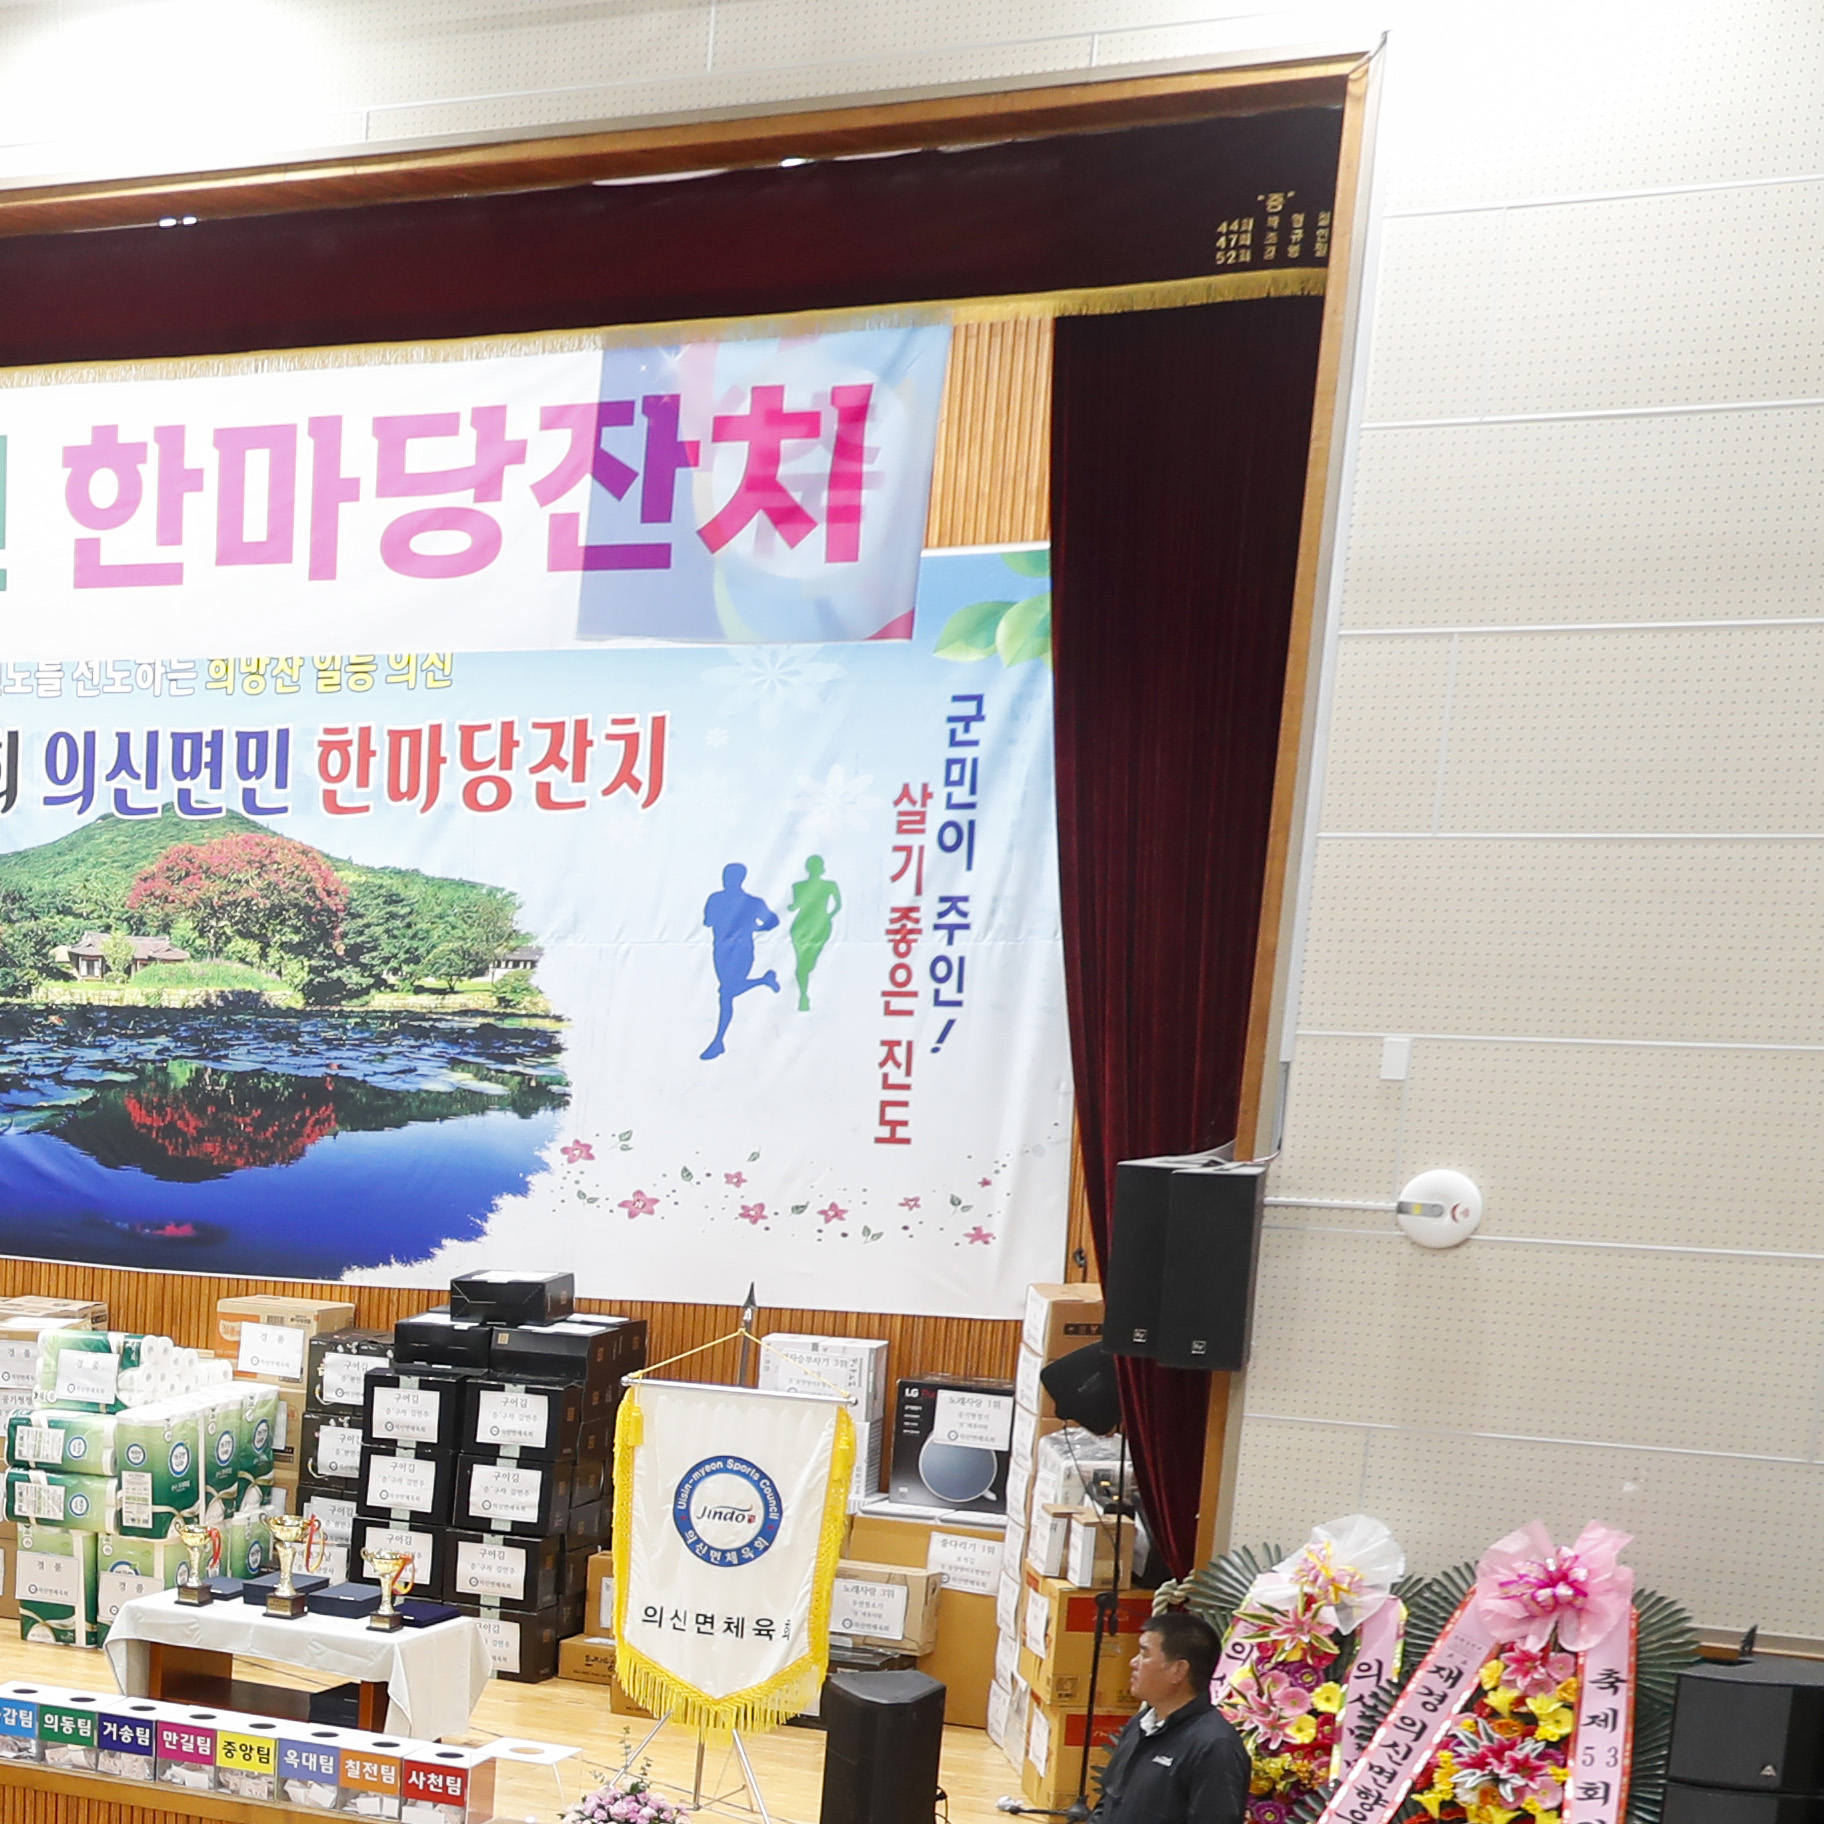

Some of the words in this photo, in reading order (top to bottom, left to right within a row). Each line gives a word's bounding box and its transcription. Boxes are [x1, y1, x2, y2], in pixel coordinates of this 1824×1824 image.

[61, 381, 876, 591] 한마당잔치
[42, 725, 292, 816] 의신면민
[315, 710, 670, 816] 한마당잔치
[937, 693, 986, 871] 군민이
[929, 895, 971, 1054] 주인!
[874, 1038, 914, 1145] 진도
[905, 1387, 919, 1398] LG
[676, 1460, 724, 1510] Uisin-myeon
[726, 1458, 761, 1481] Sports
[759, 1479, 780, 1520] Council
[696, 1505, 746, 1525] Jindo
[684, 1529, 769, 1565] 의신면체육회
[940, 1538, 976, 1553] 줄다리기
[842, 1584, 877, 1598] 노래자랑
[1416, 1664, 1464, 1713] 재경
[1588, 1667, 1628, 1696] 축
[43, 1713, 93, 1738] 의동팀
[102, 1722, 151, 1747] 거송팀
[162, 1730, 212, 1756] 만길팀
[222, 1741, 271, 1766] 중앙팀
[283, 1749, 335, 1775] 옥대팀
[345, 1758, 397, 1785] 칠전팀
[1575, 1707, 1619, 1808] 제53회
[407, 1769, 463, 1797] 사천팀
